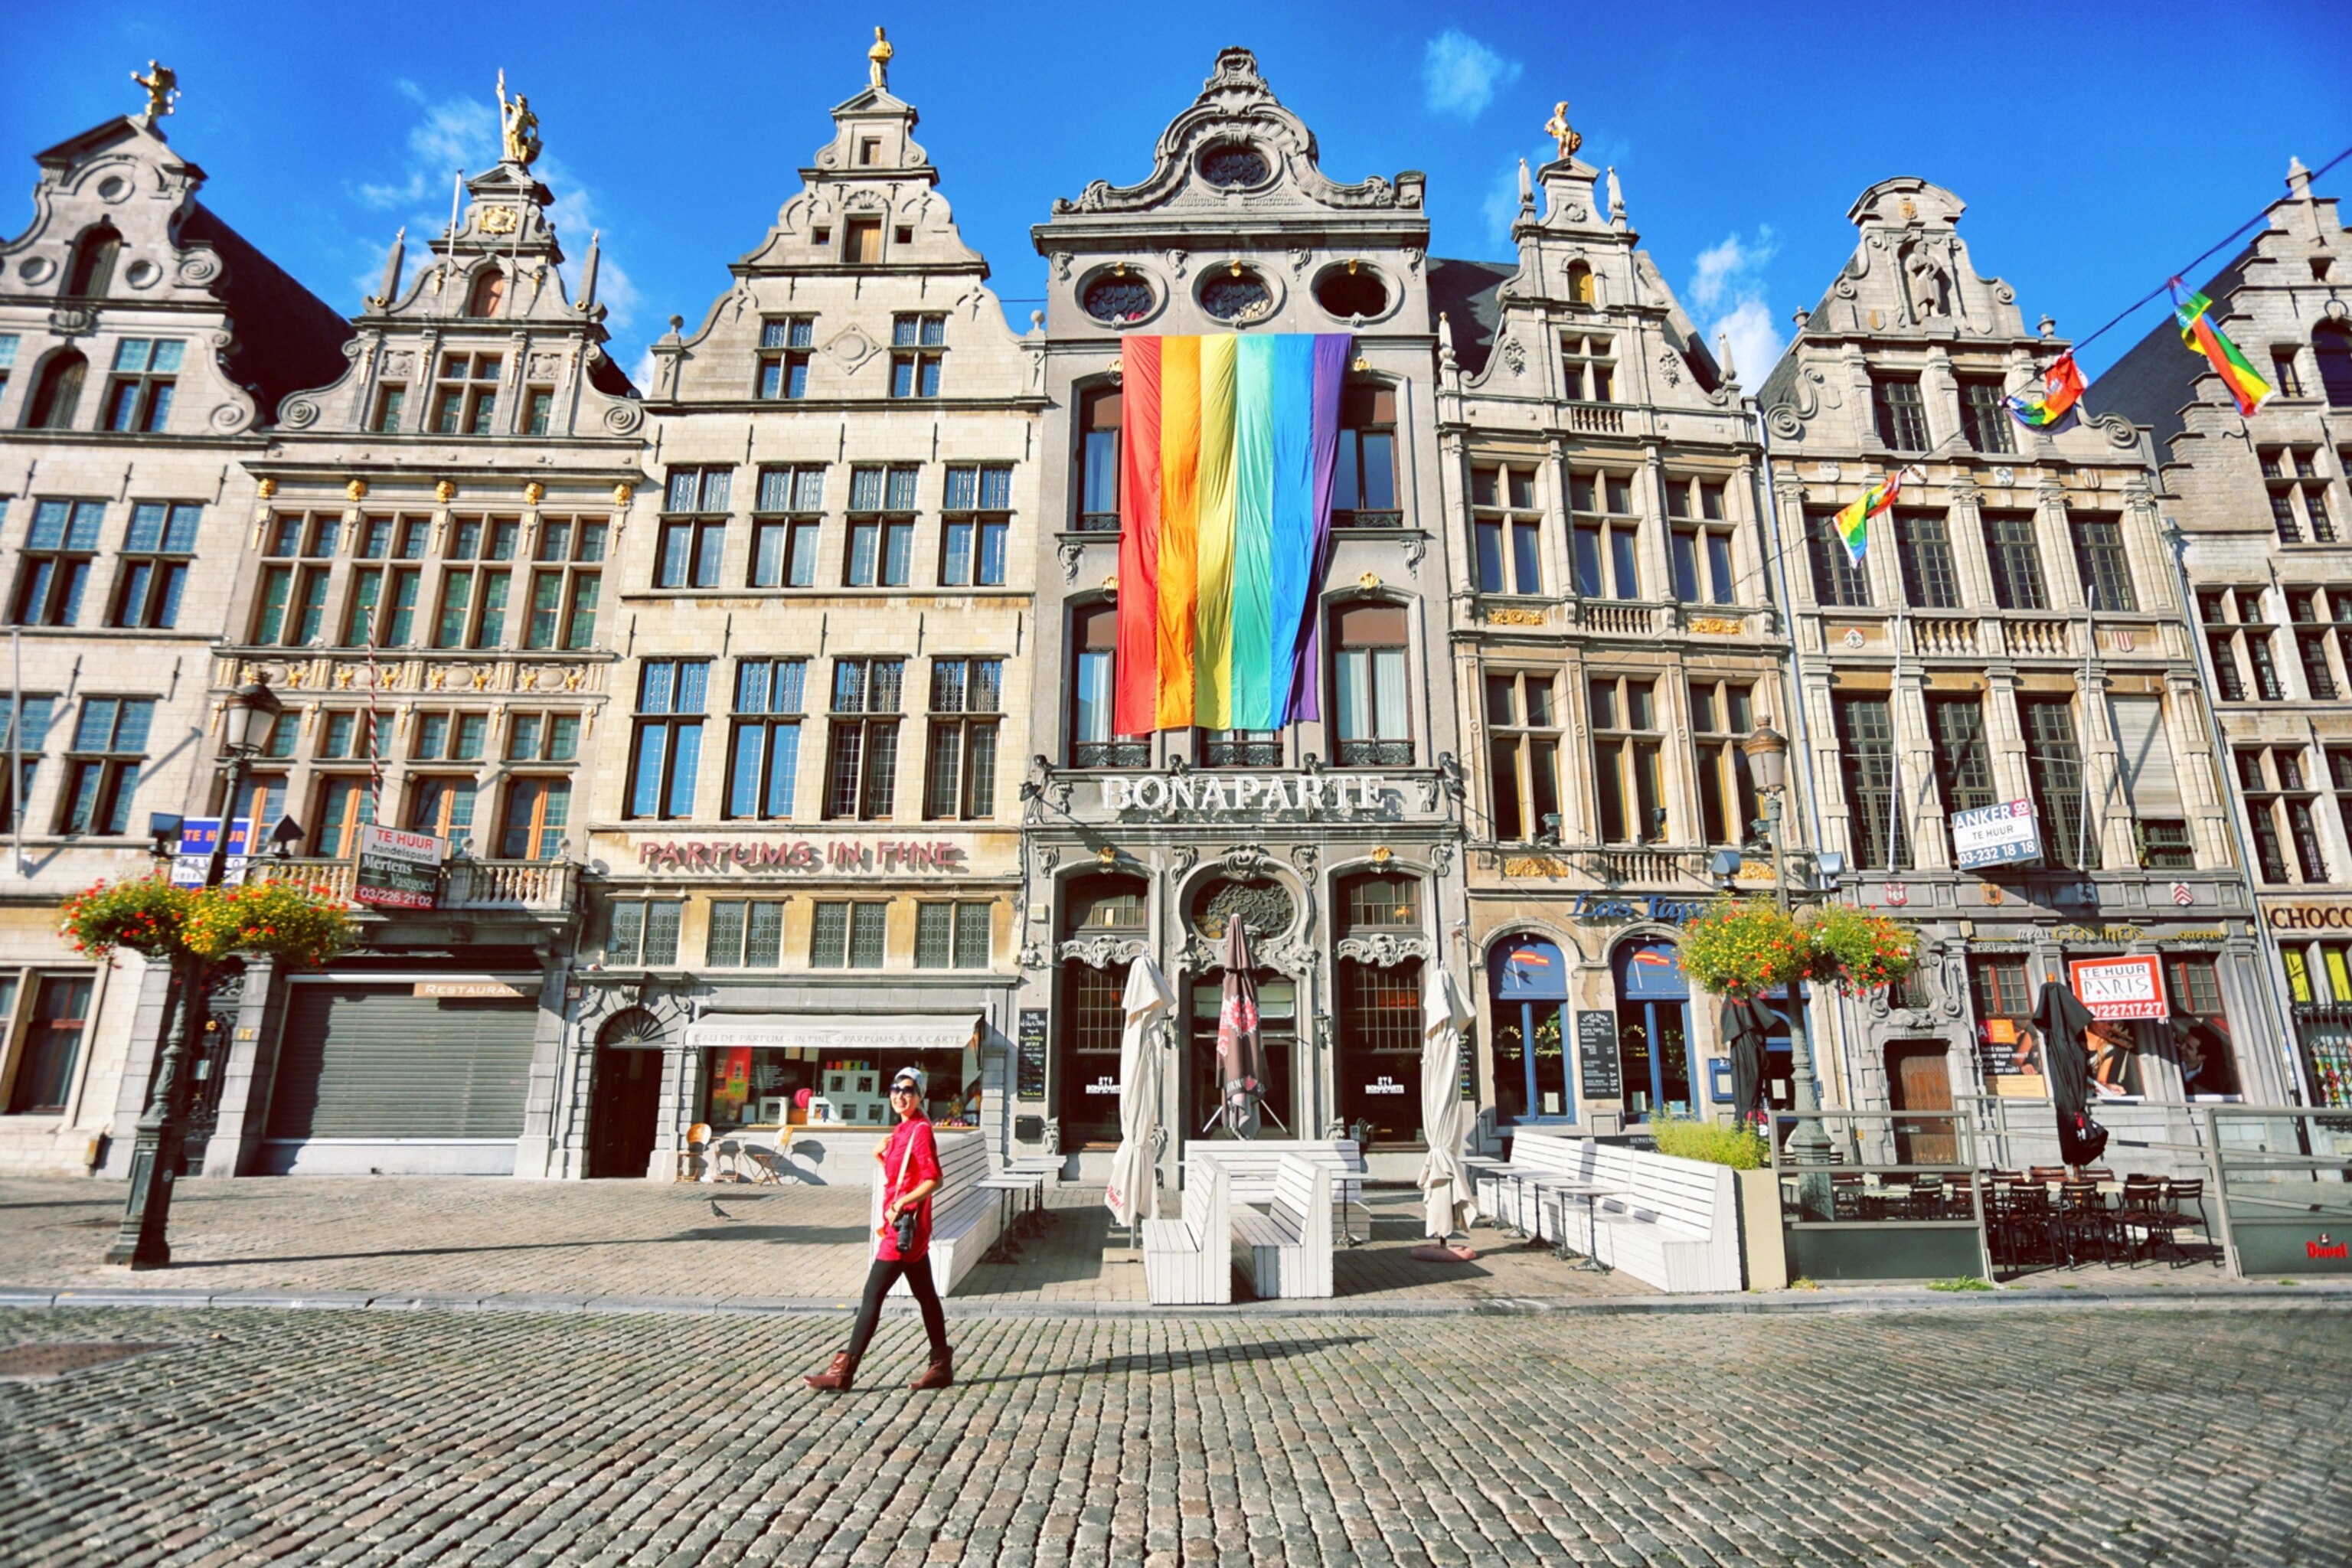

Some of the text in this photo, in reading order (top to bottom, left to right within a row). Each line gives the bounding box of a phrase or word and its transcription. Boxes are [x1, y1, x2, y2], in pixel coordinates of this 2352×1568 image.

[1101, 774, 1385, 811] BONAPARTE
[1955, 805, 2012, 829] ANKER
[184, 829, 202, 841] TE
[376, 829, 434, 850] TE HUUR
[1972, 825, 2014, 841] TE HUUR
[371, 843, 434, 862] handelspand
[639, 841, 958, 866] PARFUMS IN FINE
[1959, 847, 1999, 864] 03-232
[2001, 843, 2017, 857] 18
[2020, 840, 2036, 854] 18
[363, 854, 413, 874] Mertens
[390, 873, 436, 892] Vastgoed
[359, 887, 433, 907] 03/226 21 02
[1566, 890, 1634, 918] Las
[2082, 964, 2146, 978] TE HUUR
[424, 984, 527, 995] RESTAURANT
[2083, 977, 2149, 995] PARIS
[694, 1034, 718, 1044] EAU
[720, 1034, 737, 1043] DE
[740, 1034, 784, 1044] PARFUM
[795, 1034, 805, 1043] IN
[808, 1034, 831, 1044] FINE
[844, 1034, 895, 1044] PARFUMS
[909, 1034, 924, 1044] LA
[925, 1034, 962, 1044] CARTE
[2305, 1240, 2348, 1259] Duvel
